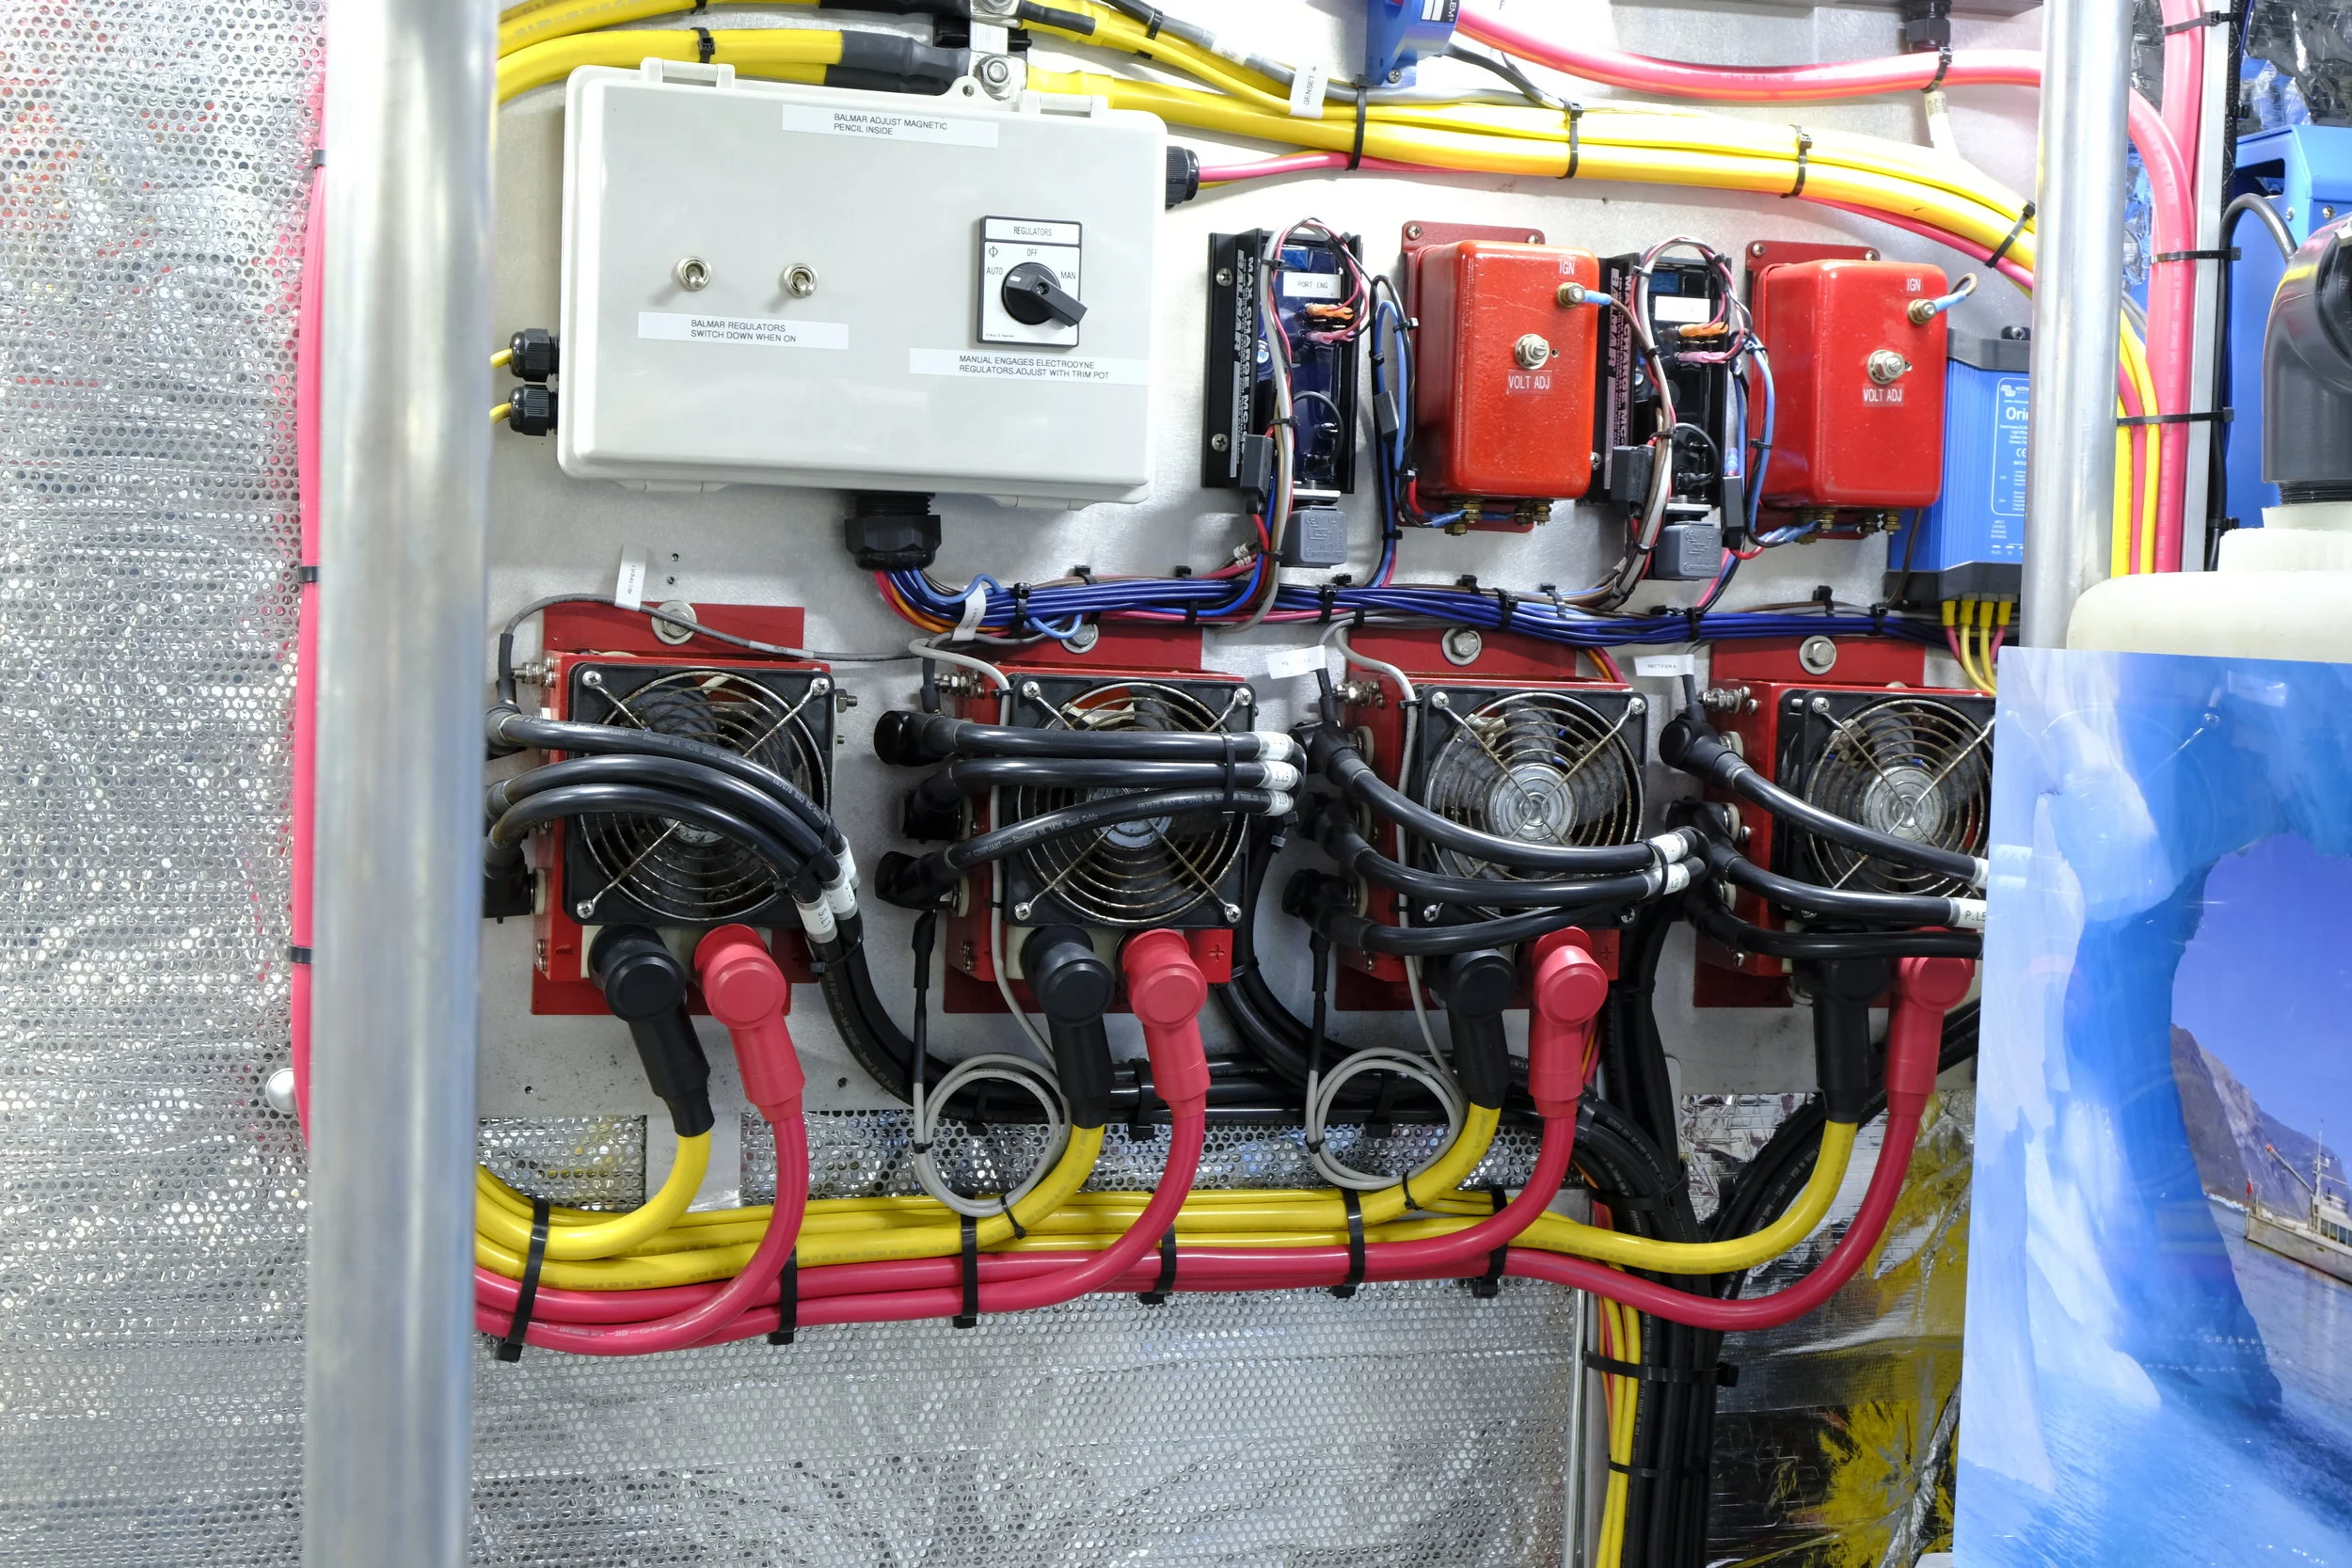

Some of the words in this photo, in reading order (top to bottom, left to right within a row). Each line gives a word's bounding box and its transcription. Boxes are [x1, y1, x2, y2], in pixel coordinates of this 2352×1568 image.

[1303, 75, 1315, 104] GENSET
[834, 113, 867, 123] BALMAR
[869, 116, 901, 126] ADJUST
[903, 119, 947, 130] MAGNETIC
[834, 123, 863, 133] PENCIL
[866, 126, 893, 135] INSIDE
[1013, 226, 1052, 237] REGULATORS
[1026, 248, 1039, 257] OFF
[986, 266, 1003, 276] AUTO
[1060, 271, 1076, 279] MAN
[1558, 261, 1575, 275] IGN
[1297, 280, 1313, 289] PORT
[1316, 281, 1328, 290] ENG
[1906, 277, 1921, 292] IGN
[1233, 249, 1245, 352] BALMAR
[691, 320, 725, 328] BALMAR
[727, 322, 786, 333] REGULATORS
[691, 329, 723, 339] SWITCH
[726, 331, 754, 340] DOWN
[755, 333, 782, 342] WHEN
[783, 335, 797, 343] ON
[1243, 306, 1252, 388] CHARGE
[959, 355, 993, 364] MANUAL
[994, 357, 1034, 367] ENGAGES
[1036, 359, 1095, 370] ELECTRODYNE
[1621, 324, 1630, 404] CHARGE
[1072, 370, 1092, 378] TRIM
[1093, 371, 1109, 379] POT
[1507, 374, 1531, 388] VOLT
[1534, 375, 1550, 389] ADJ
[1862, 387, 1883, 402] VOLT
[1885, 388, 1903, 402] ADJ
[684, 742, 701, 752] 1426
[973, 841, 1002, 857] COMPLIANT
[1012, 830, 1036, 844] Standard
[1039, 828, 1046, 836] UL
[1049, 821, 1064, 832] 1426
[1066, 817, 1079, 828] Boat
[1082, 812, 1098, 823] Cable
